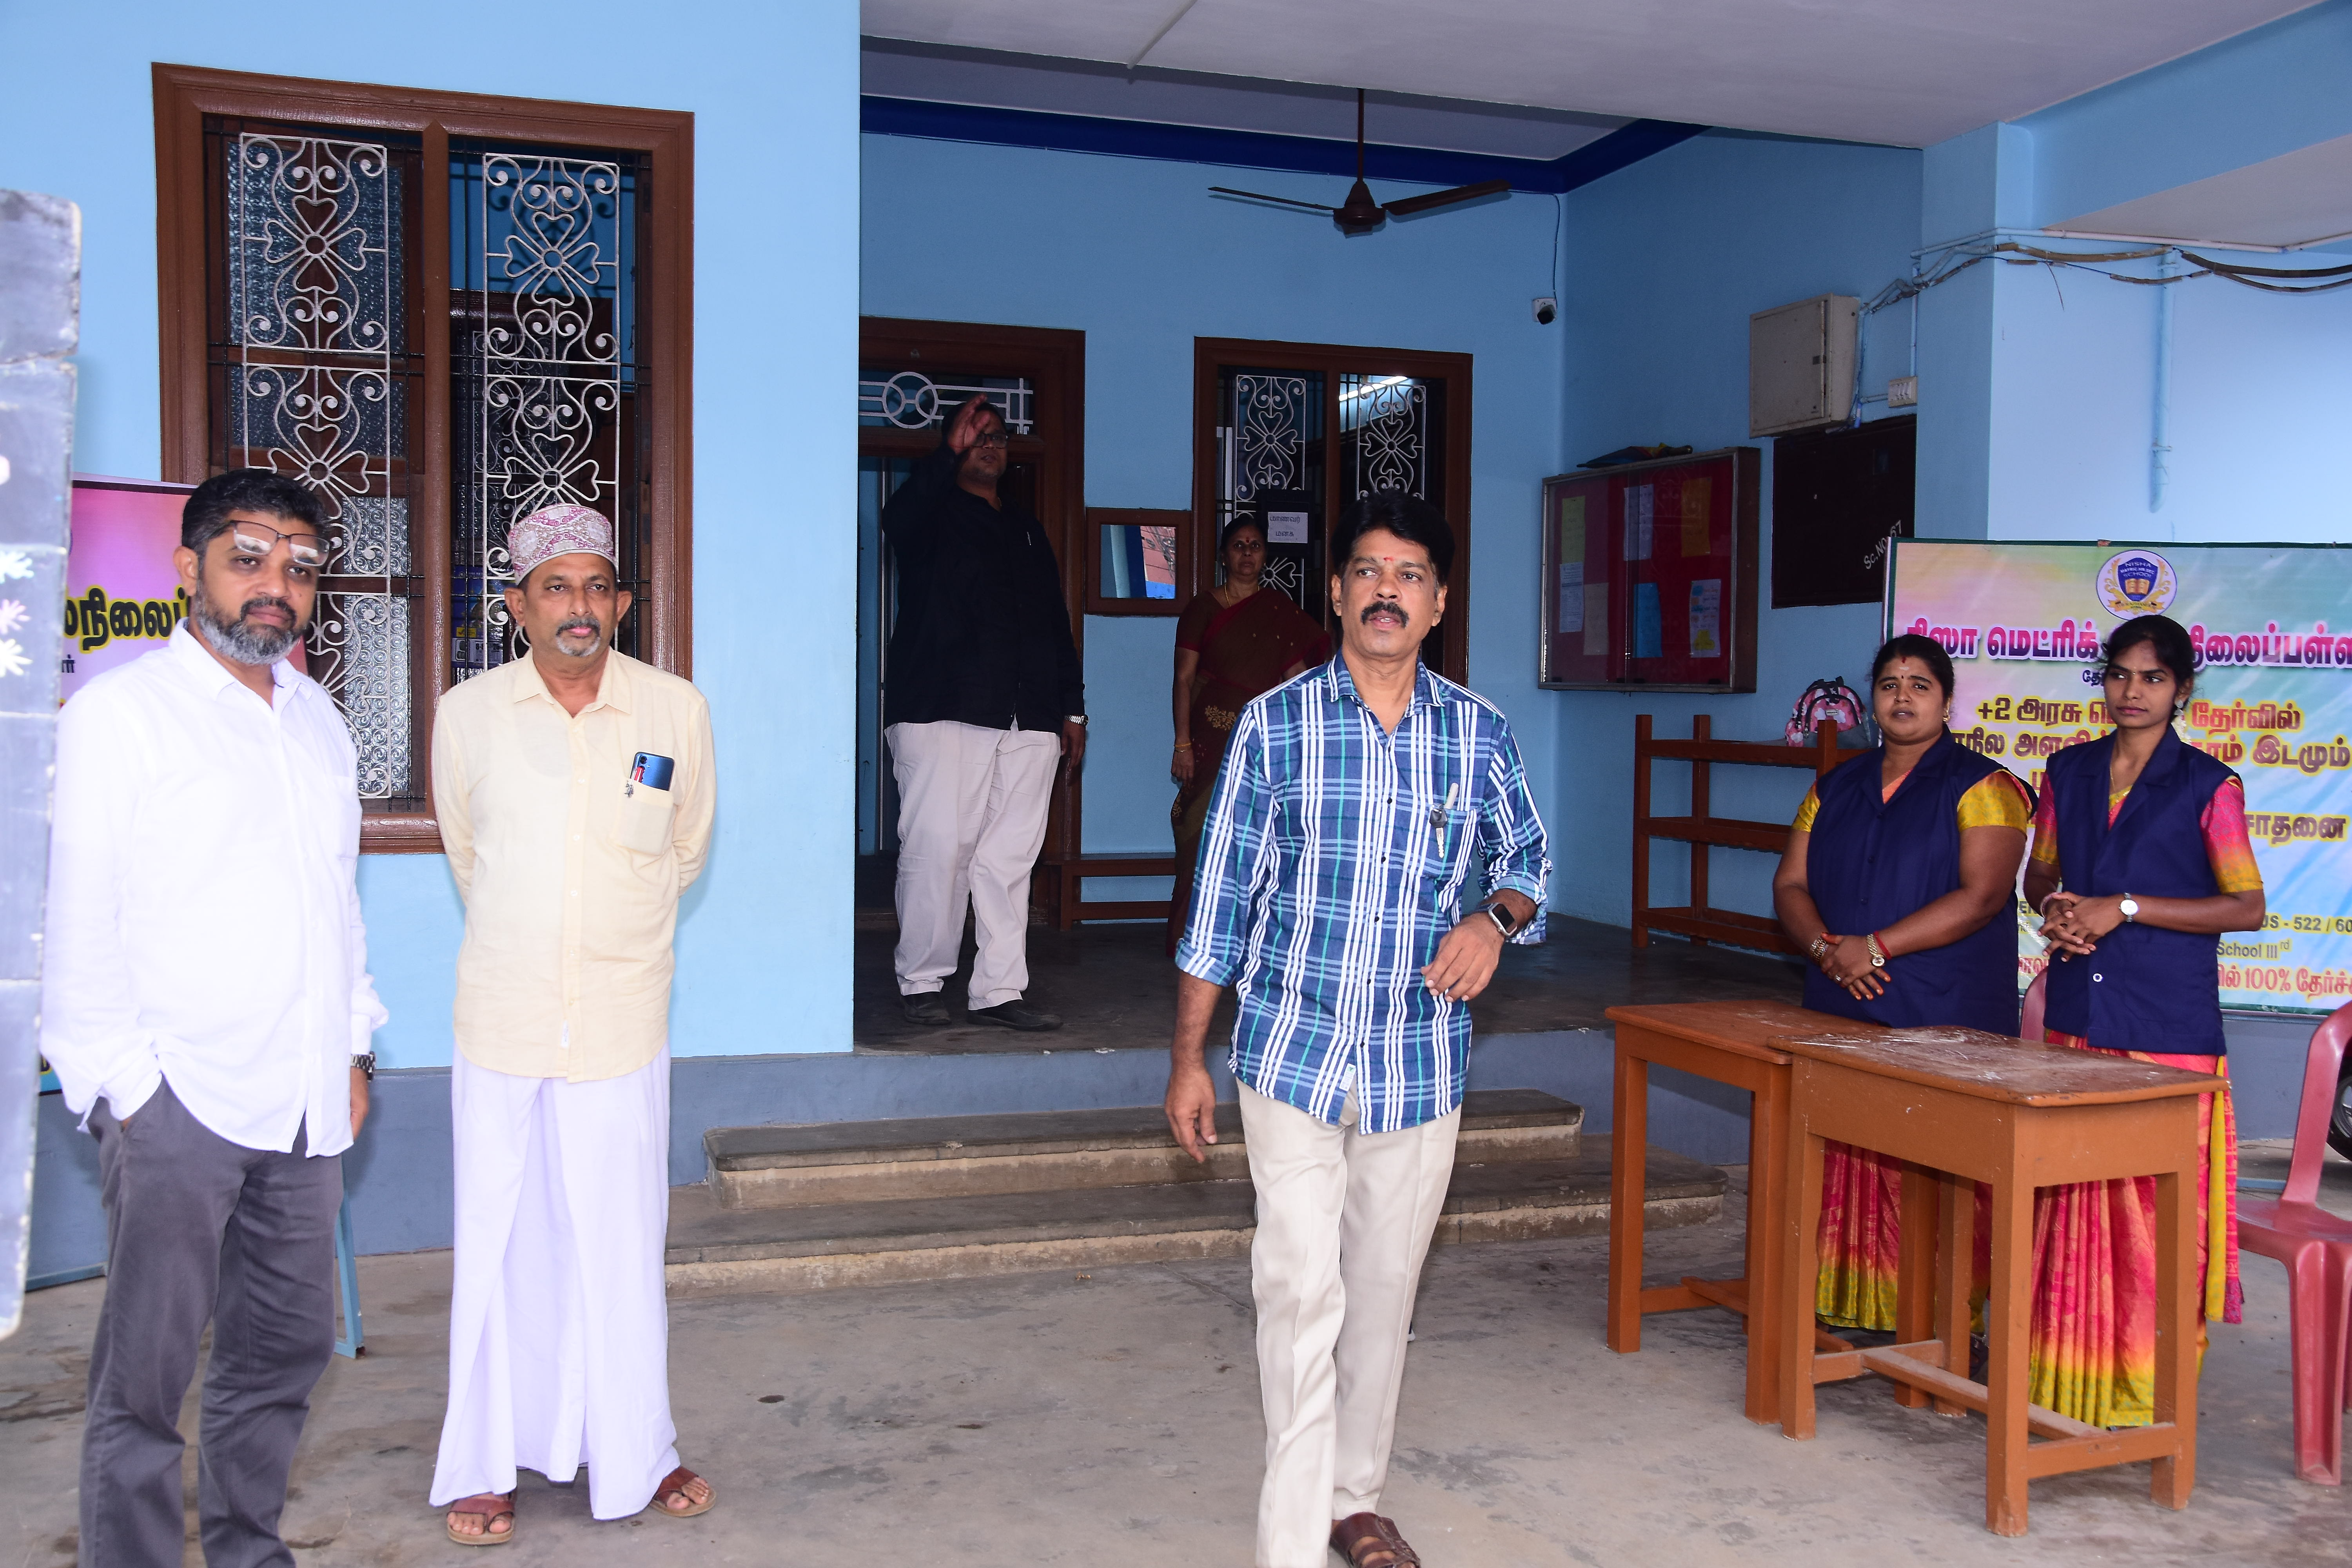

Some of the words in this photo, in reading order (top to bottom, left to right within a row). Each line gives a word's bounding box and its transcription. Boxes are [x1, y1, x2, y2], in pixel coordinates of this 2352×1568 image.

[1270, 515, 1300, 524] மாணவர்
[1988, 619, 2098, 659] மெட்ரிக்
[1978, 697, 2011, 720] +2
[2017, 699, 2082, 726] அரசு
[2192, 701, 2301, 735] தேர்வில்
[2253, 734, 2350, 773] இடமும்
[2294, 916, 2321, 931] 522
[2216, 942, 2262, 958] School
[2245, 967, 2291, 993] 100%
